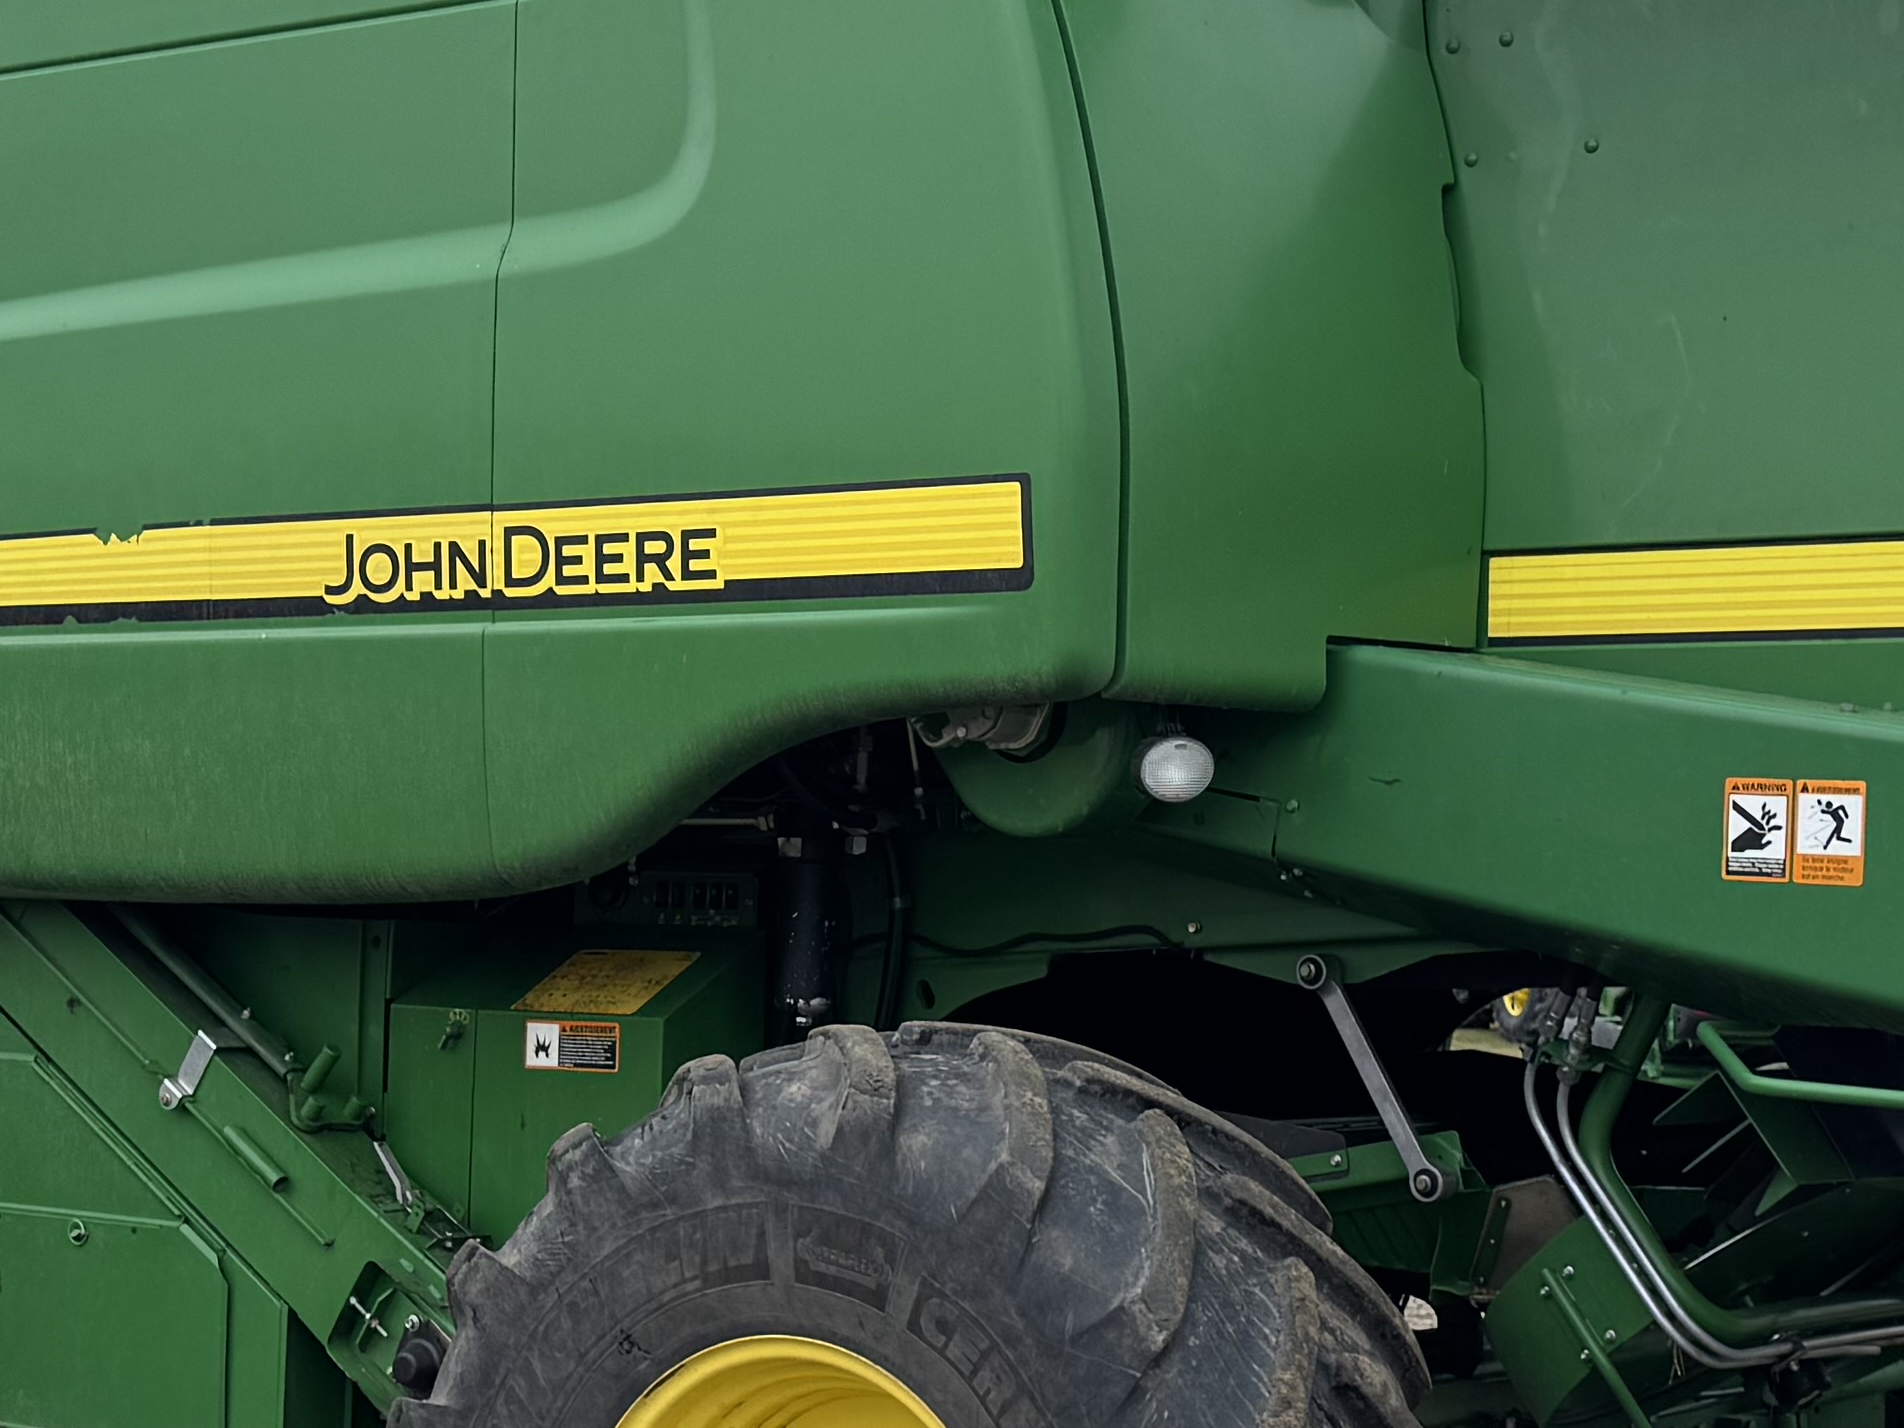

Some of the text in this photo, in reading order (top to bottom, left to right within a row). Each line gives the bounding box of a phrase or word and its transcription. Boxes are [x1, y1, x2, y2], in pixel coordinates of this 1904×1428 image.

[324, 525, 718, 596] JOHN DEERE
[1741, 782, 1787, 793] WARNING
